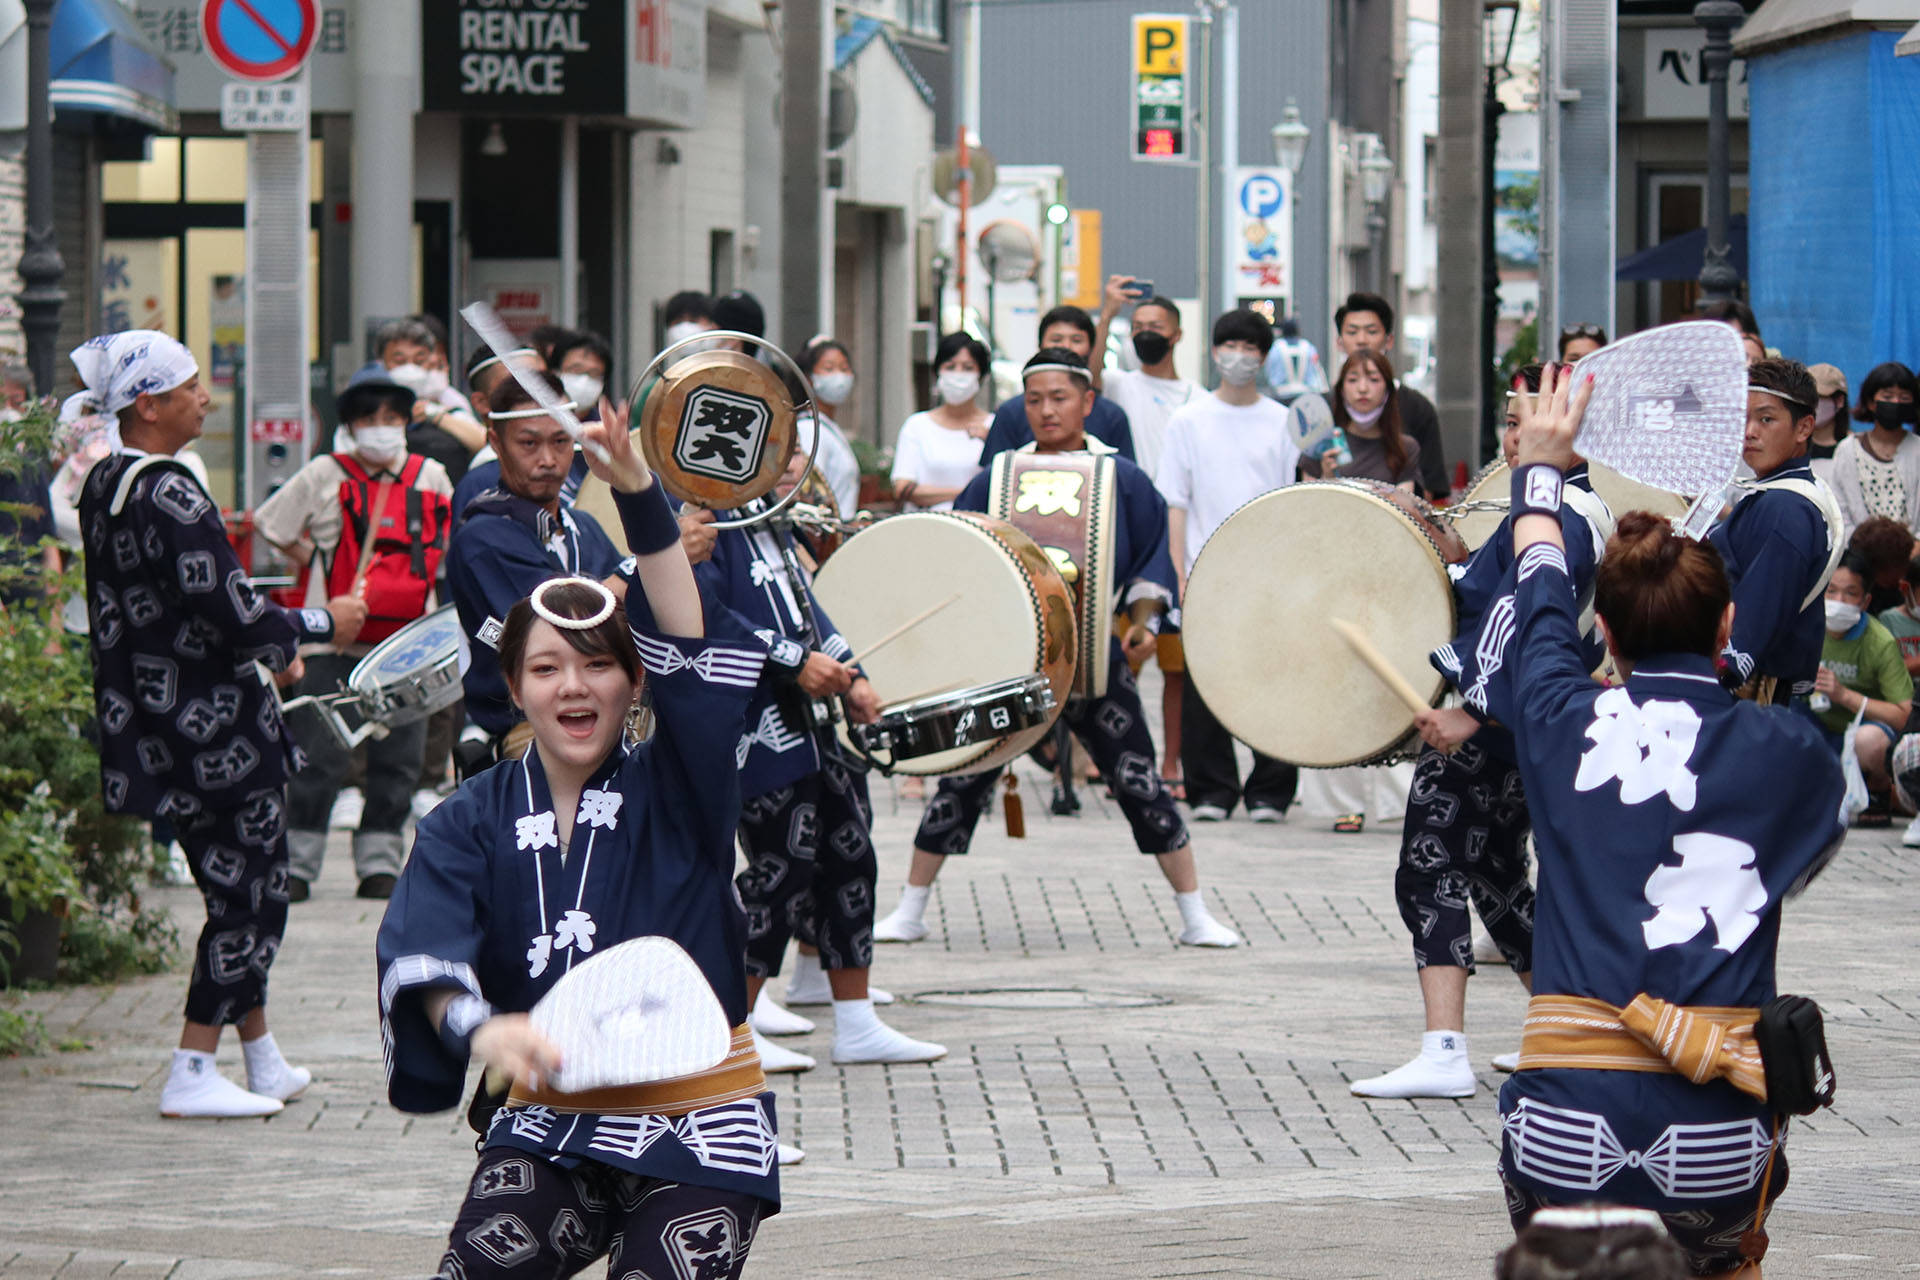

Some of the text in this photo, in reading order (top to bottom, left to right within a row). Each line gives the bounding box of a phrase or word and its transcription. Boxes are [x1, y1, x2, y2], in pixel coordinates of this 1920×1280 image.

[460, 12, 590, 51] RENTAL
[1146, 27, 1176, 66] P
[460, 54, 566, 95] SPACE
